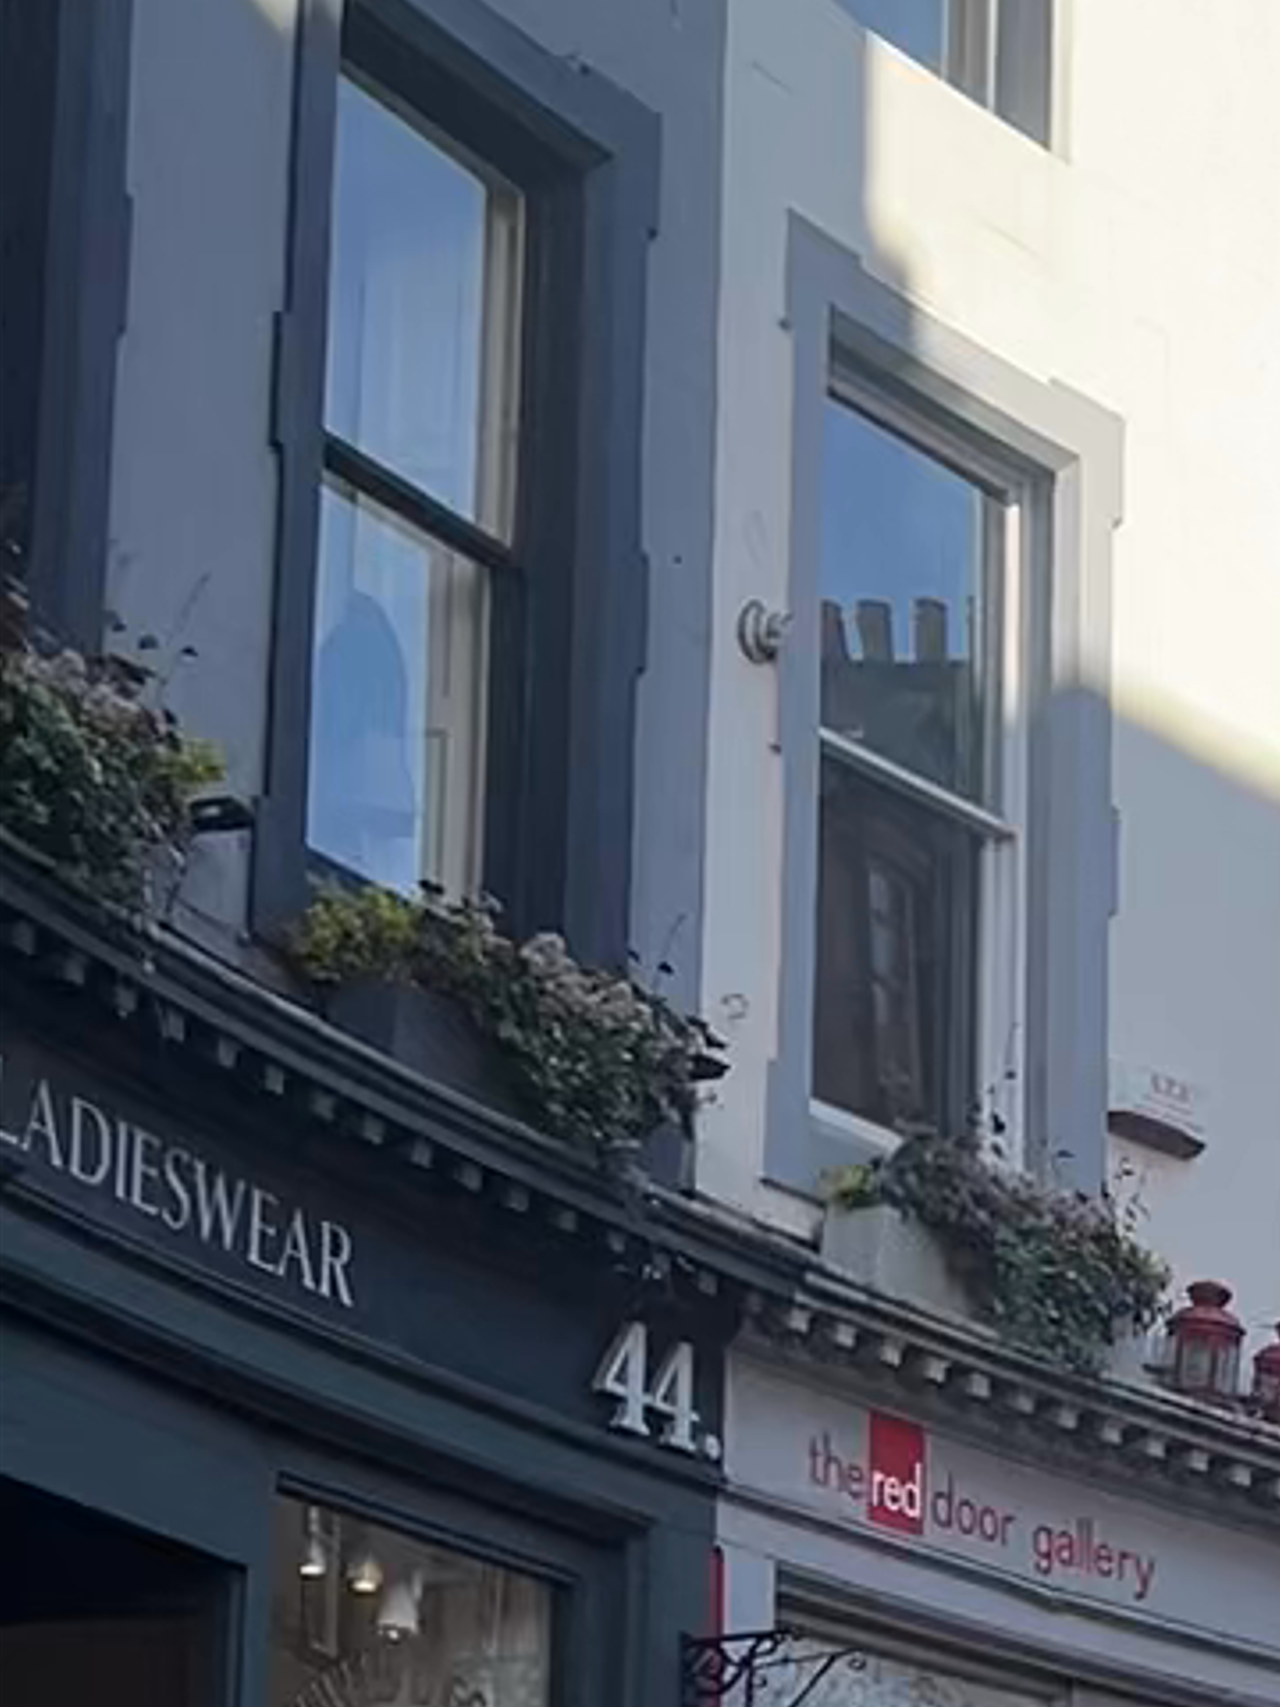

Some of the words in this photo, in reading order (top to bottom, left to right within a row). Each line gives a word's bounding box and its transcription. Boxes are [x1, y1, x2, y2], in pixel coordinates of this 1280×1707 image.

[809, 1432, 864, 1499] the
[871, 1461, 923, 1520] red
[932, 1473, 1015, 1546] door
[1033, 1517, 1156, 1600] gallery
